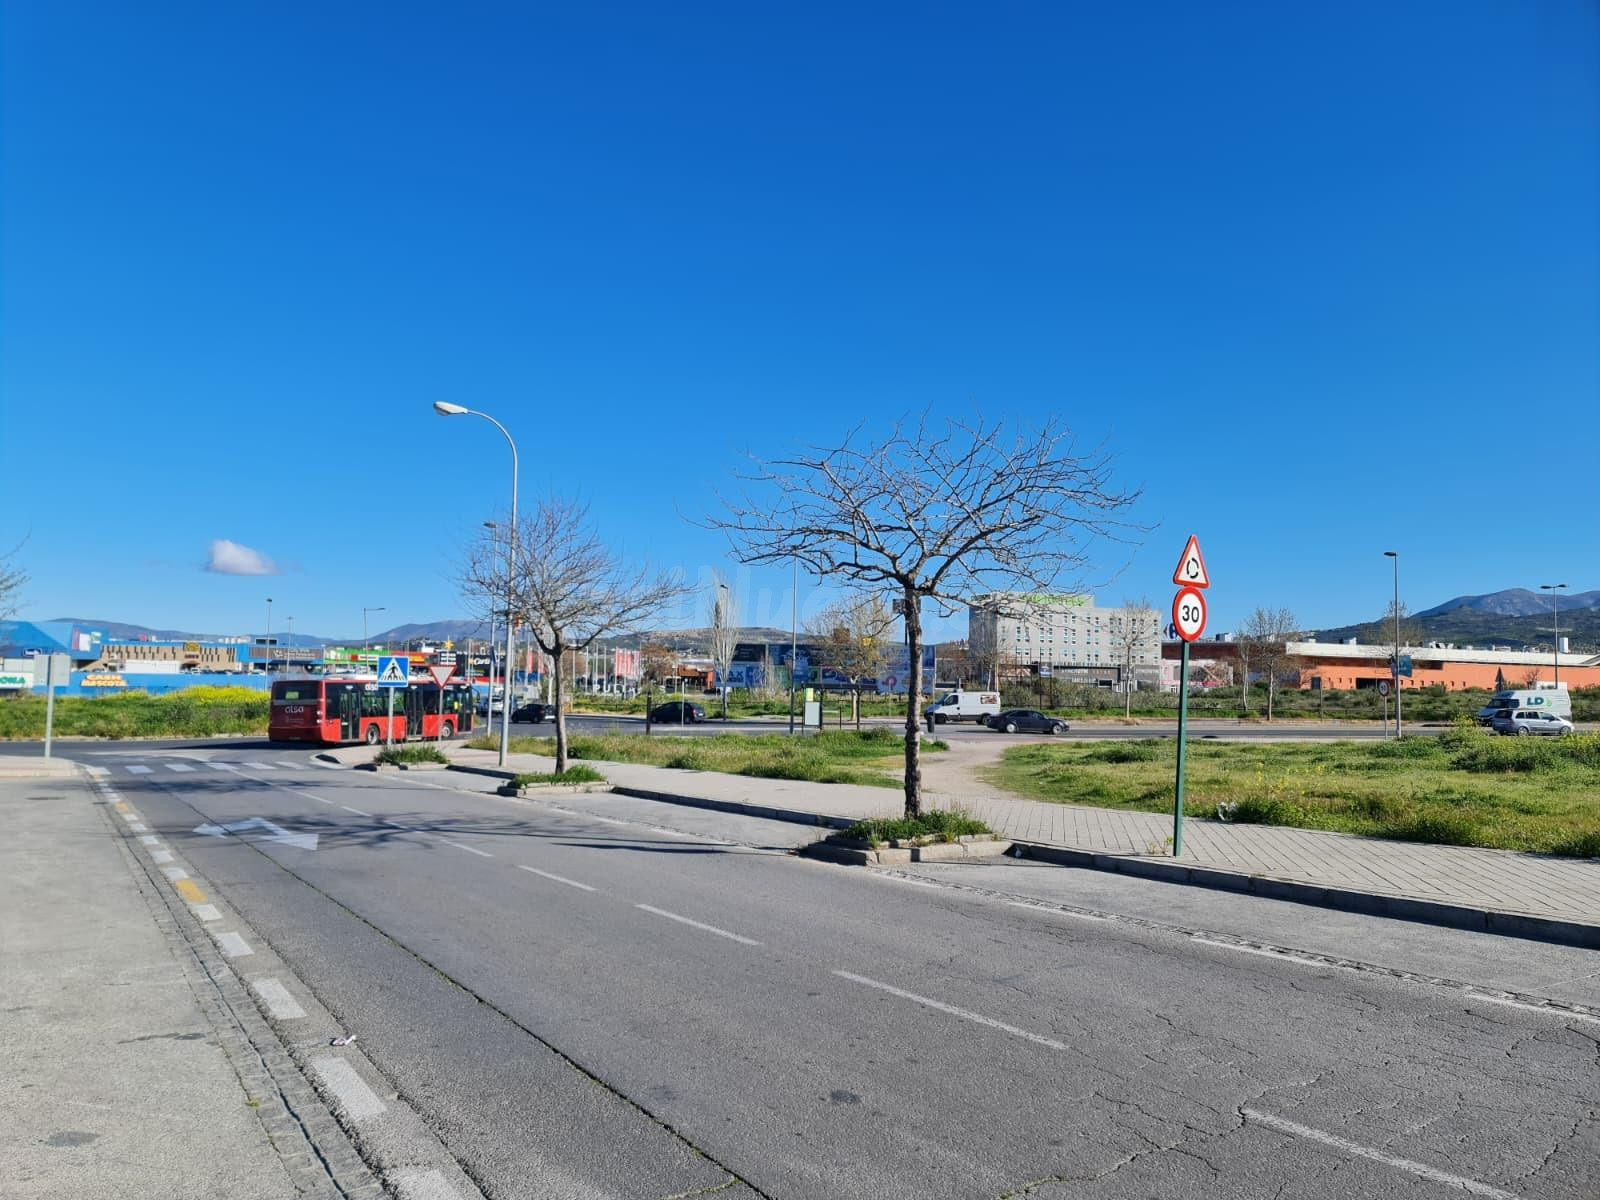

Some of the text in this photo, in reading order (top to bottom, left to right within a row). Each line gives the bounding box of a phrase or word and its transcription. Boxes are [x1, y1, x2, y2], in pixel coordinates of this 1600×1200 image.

[1182, 605, 1199, 623] 30
[1526, 696, 1544, 706] LD
[284, 704, 304, 714] alsa
